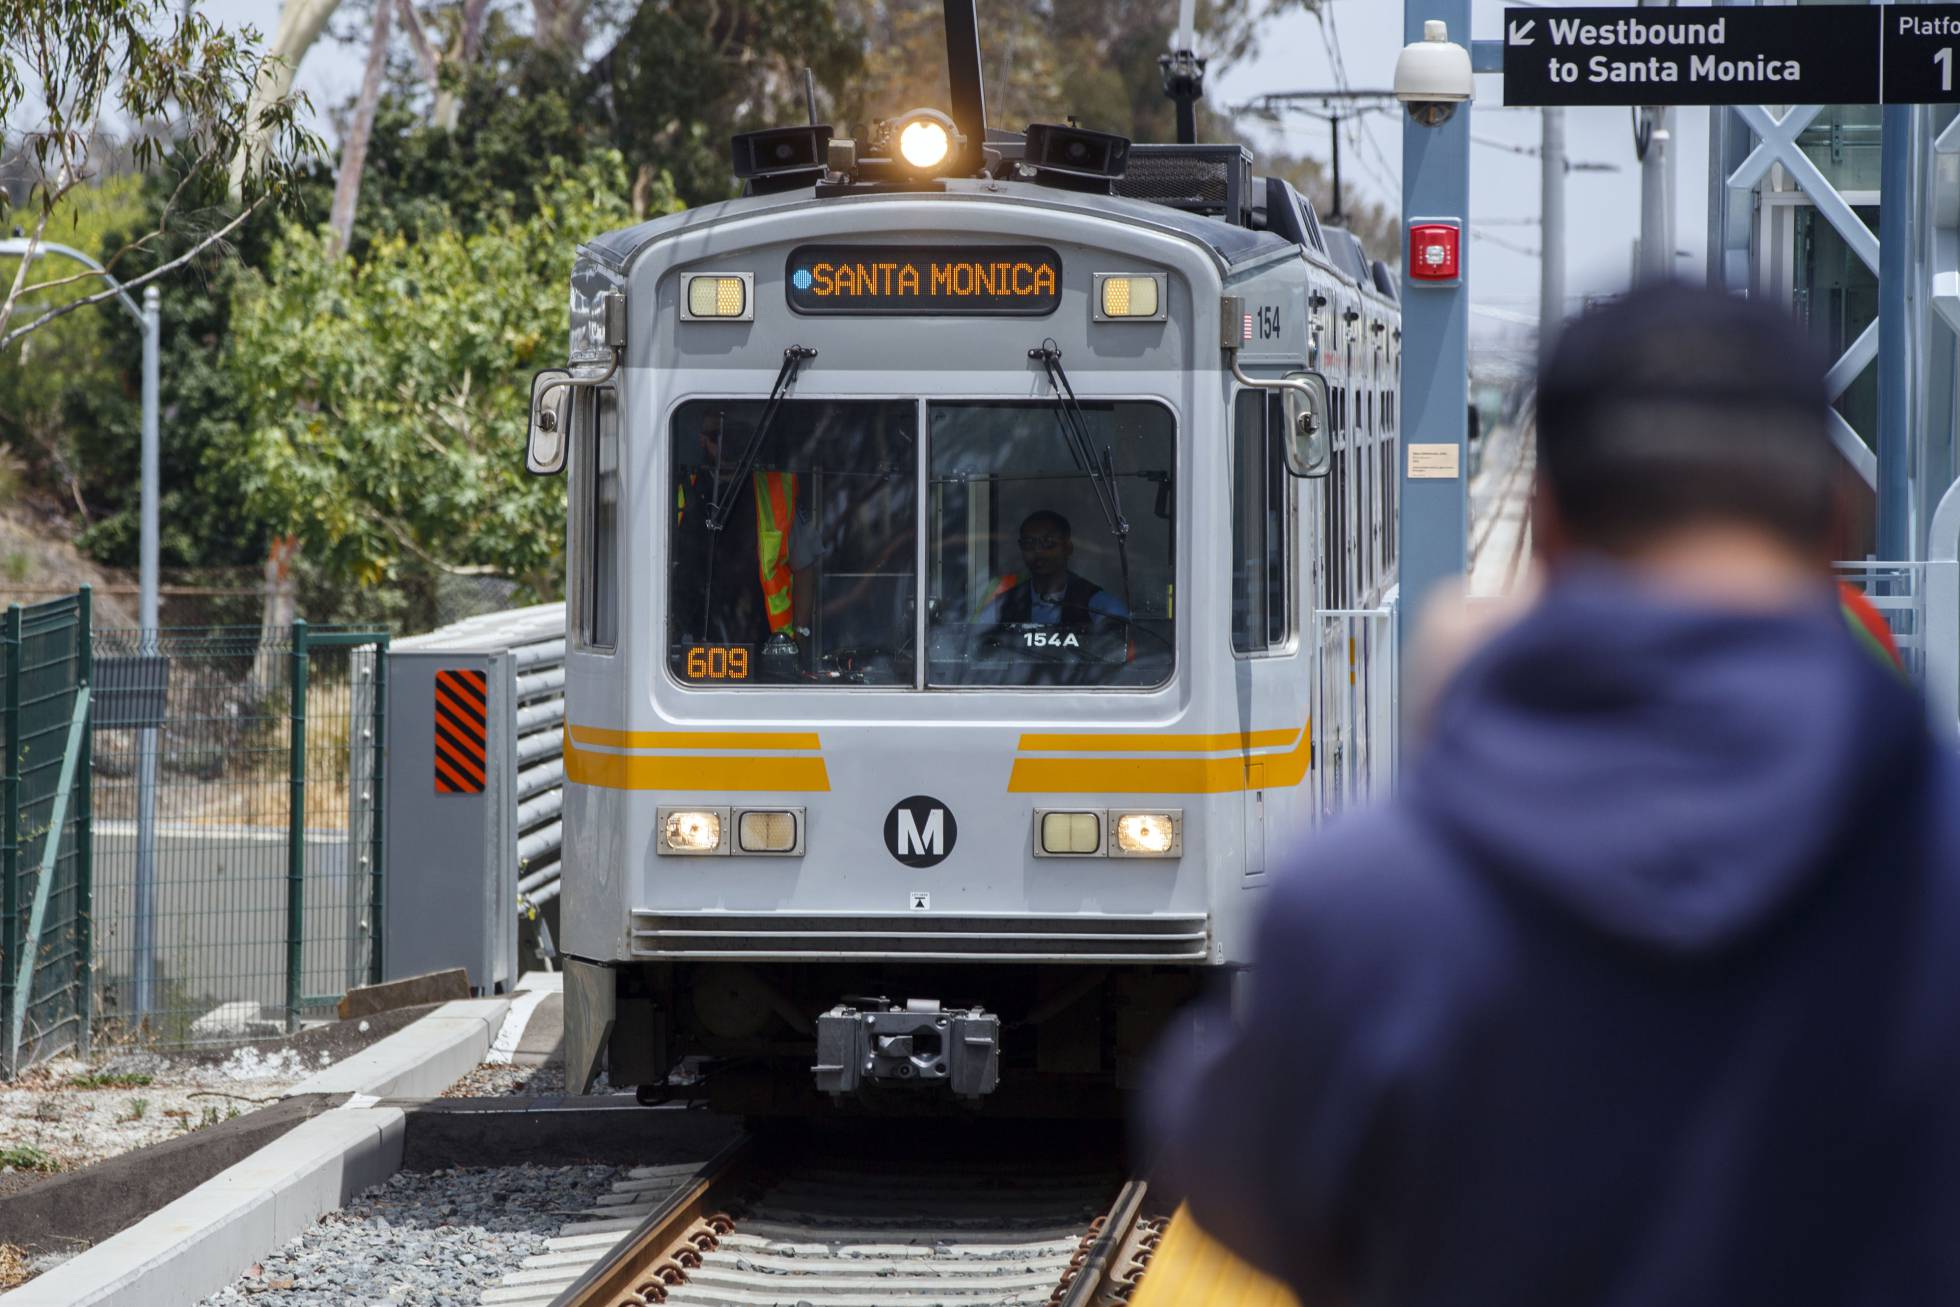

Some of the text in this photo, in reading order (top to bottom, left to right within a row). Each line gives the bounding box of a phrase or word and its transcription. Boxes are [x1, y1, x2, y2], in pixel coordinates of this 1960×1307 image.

[1549, 18, 1726, 46] Westbound
[1549, 54, 1801, 83] to Santa Monica
[1934, 47, 1953, 91] 1
[813, 263, 1055, 296] SANTA MONICA
[1257, 306, 1280, 340] 154
[1023, 632, 1079, 648] 154A
[687, 647, 748, 680] 609
[898, 809, 944, 855] M
